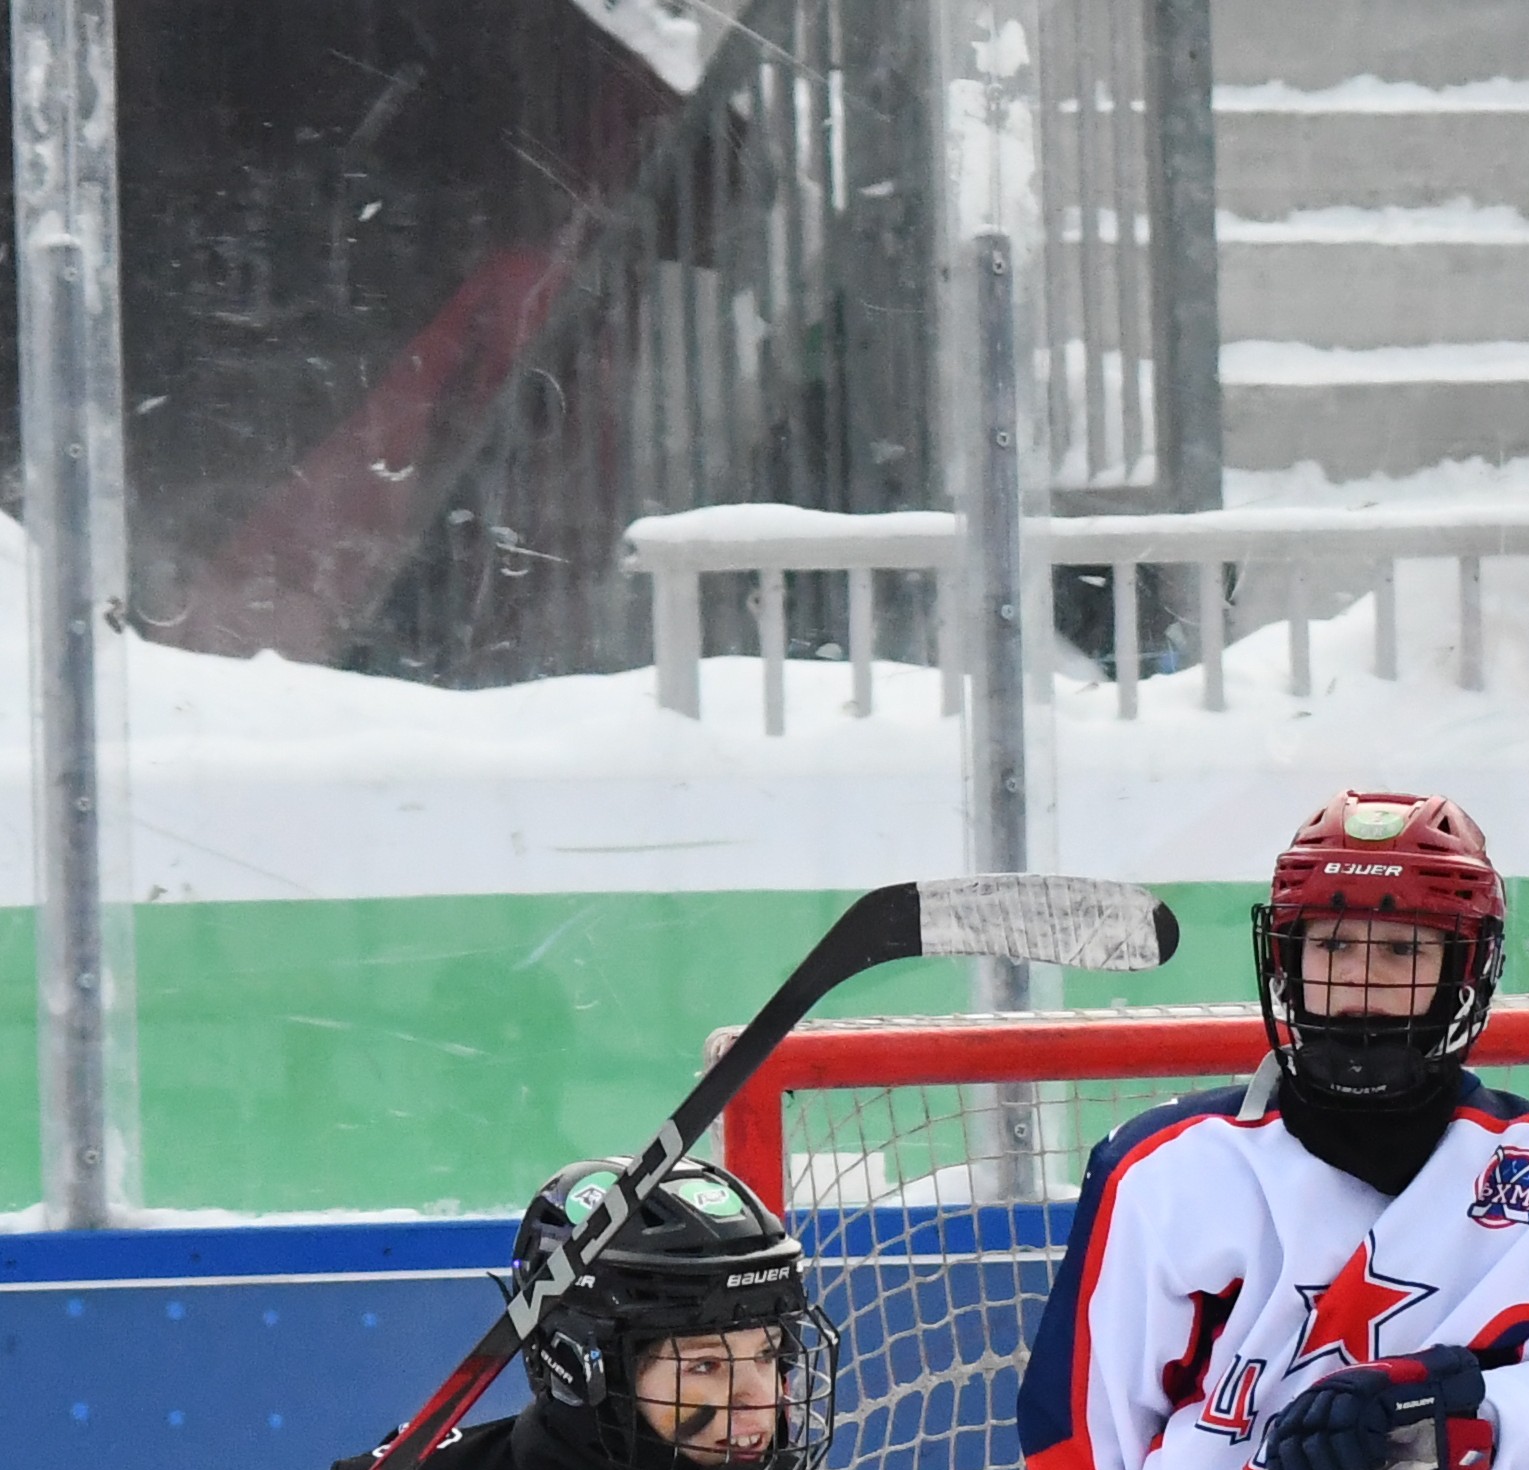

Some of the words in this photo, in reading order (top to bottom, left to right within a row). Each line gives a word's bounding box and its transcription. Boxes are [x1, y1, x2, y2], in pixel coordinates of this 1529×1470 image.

[1324, 862, 1402, 877] BAUER
[507, 1118, 684, 1340] CCM
[727, 1266, 790, 1288] BAUER
